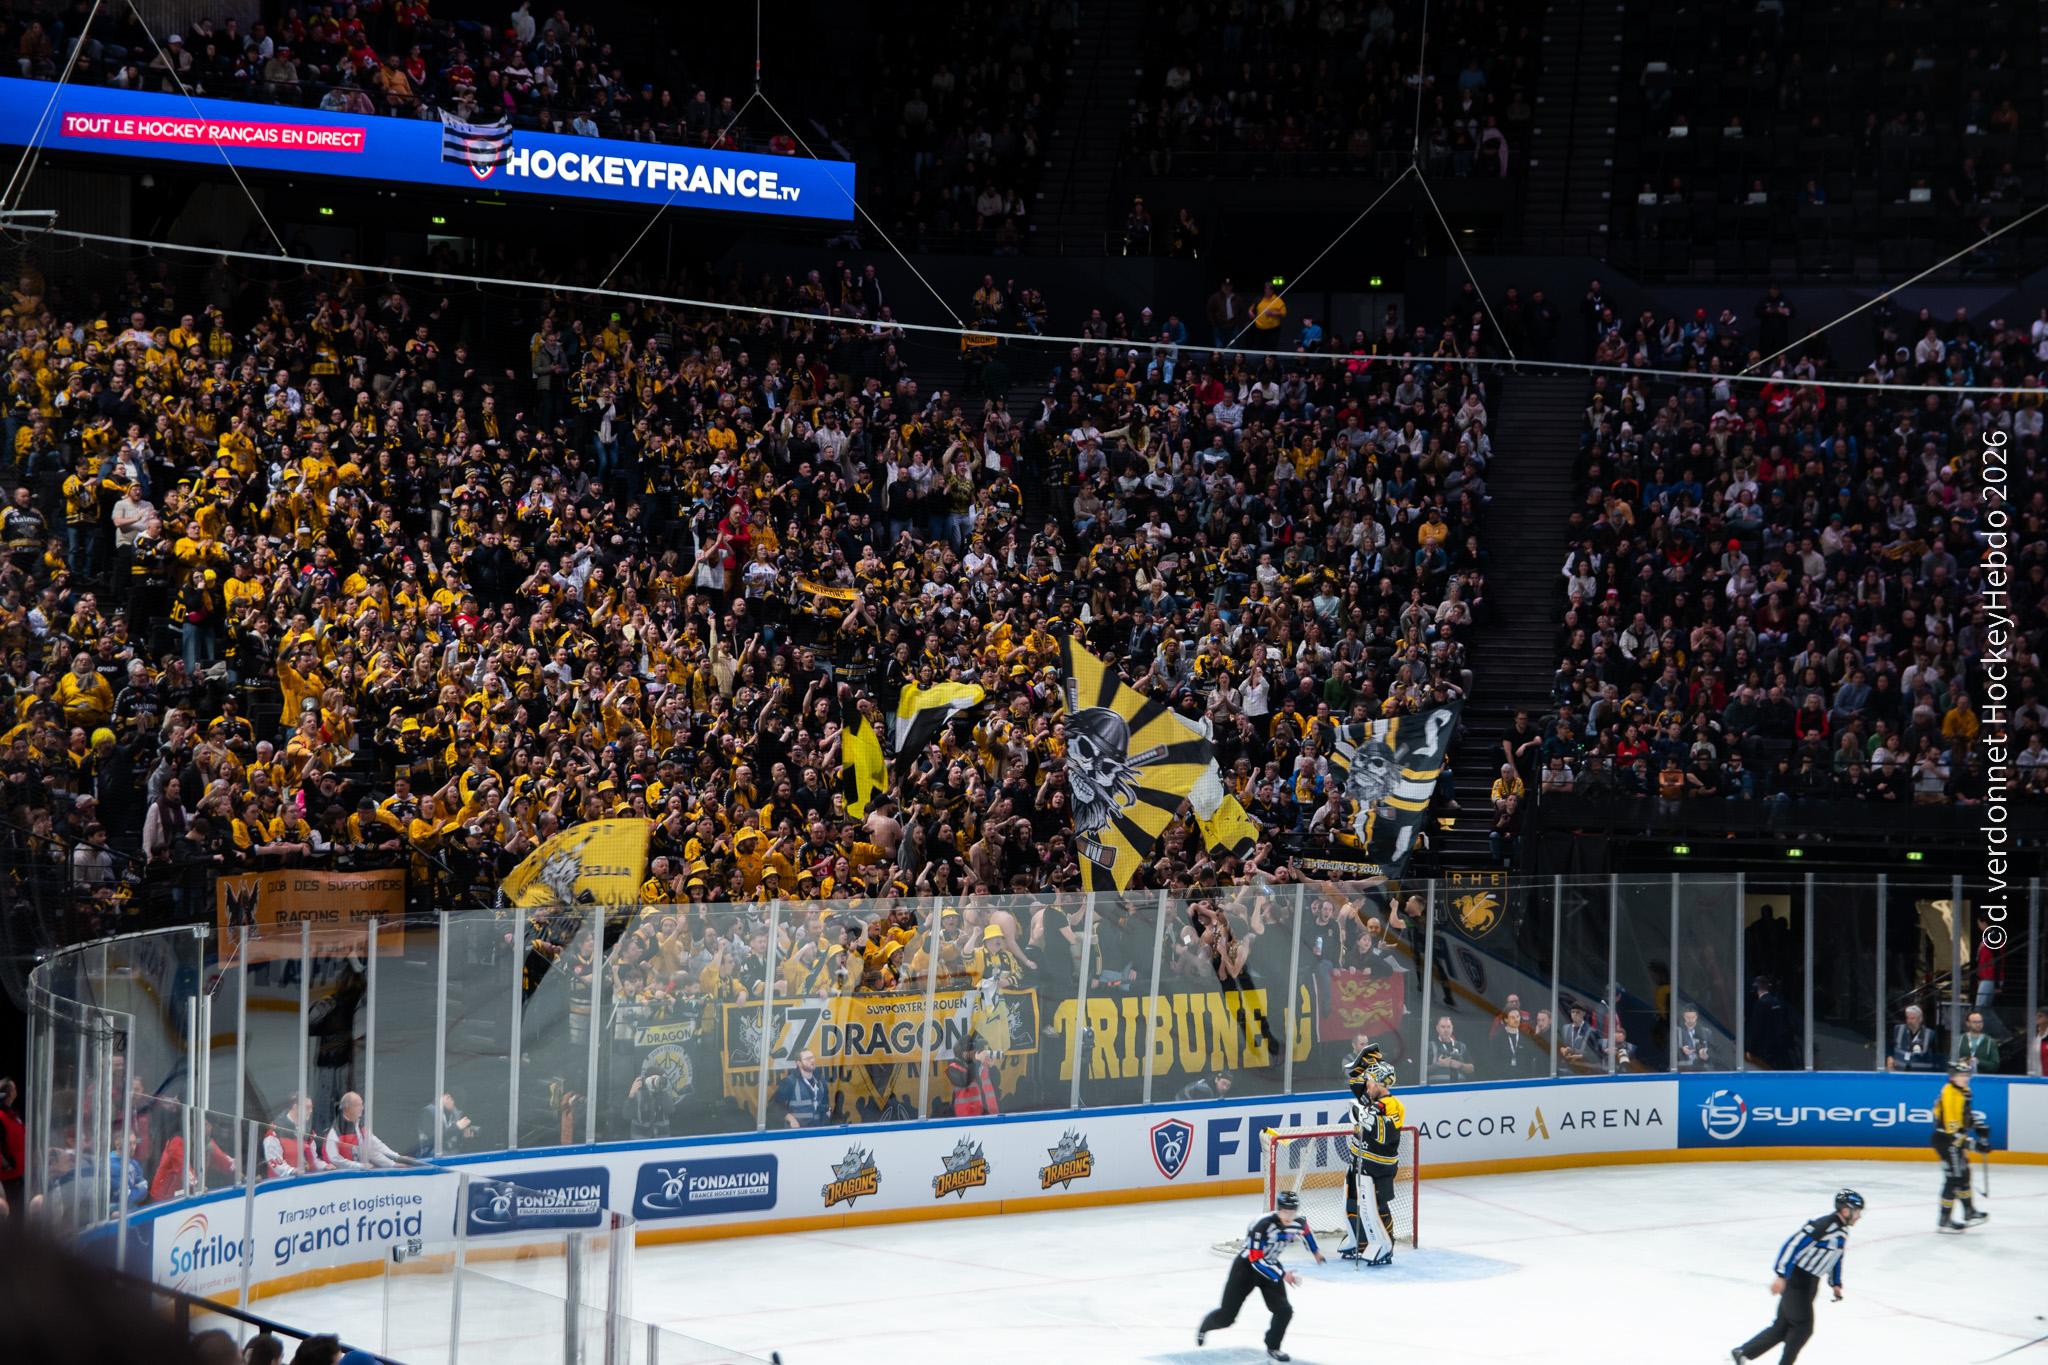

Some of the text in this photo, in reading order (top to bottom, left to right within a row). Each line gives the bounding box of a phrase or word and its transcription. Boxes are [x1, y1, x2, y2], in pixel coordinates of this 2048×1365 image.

[66, 116, 111, 133] TOUT
[114, 119, 134, 135] LE
[137, 120, 206, 139] HOCKEY
[281, 129, 302, 144] EN
[306, 131, 362, 148] DIRECT
[294, 880, 320, 891] DES
[327, 879, 403, 891] SUPPORTERS
[932, 998, 968, 1011] ROUEN
[646, 1029, 692, 1043] DRAGON
[1053, 989, 1270, 1081] TRIBUNE
[1418, 1115, 1516, 1140] ACCOR
[1560, 1108, 1663, 1131] ARENA
[689, 1171, 770, 1191] FONDATION
[825, 1173, 877, 1205] DRAGONS
[936, 1165, 986, 1197] DRAGONS
[1042, 1157, 1091, 1189] DRAGONS
[339, 1201, 350, 1213] et
[353, 1194, 423, 1214] logistique
[274, 1210, 423, 1267] grand froid
